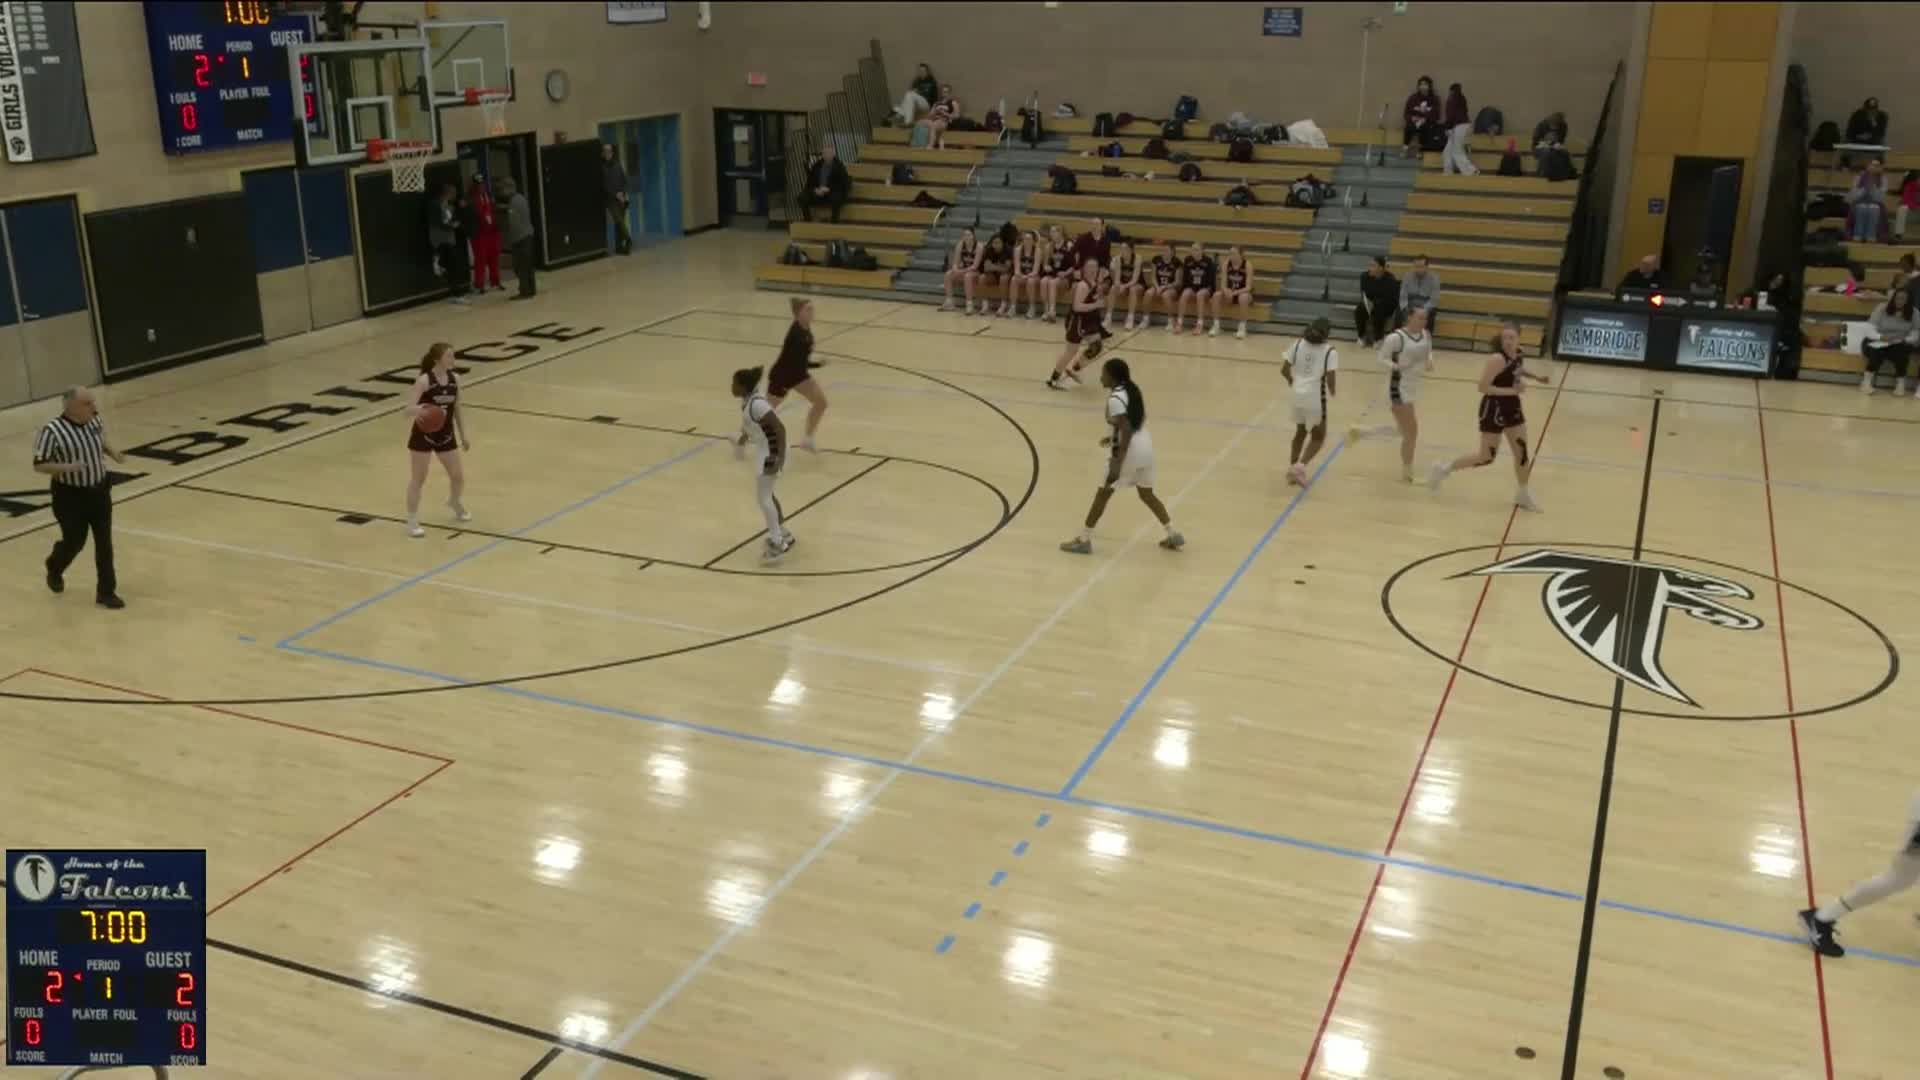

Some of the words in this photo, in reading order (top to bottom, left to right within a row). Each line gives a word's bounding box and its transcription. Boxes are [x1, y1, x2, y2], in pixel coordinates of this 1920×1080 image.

[169, 34, 203, 50] HOME
[226, 41, 253, 52] PERIOD
[270, 30, 304, 46] GUEST
[194, 54, 210, 88] 2
[241, 56, 250, 79] 1
[219, 88, 249, 100] PLAYER
[3, 83, 22, 131] GIRLS
[181, 103, 198, 130] 0
[237, 129, 263, 140] MATCH
[1562, 328, 1642, 351] CAMBRIDGE
[1696, 337, 1768, 361] FALCONS
